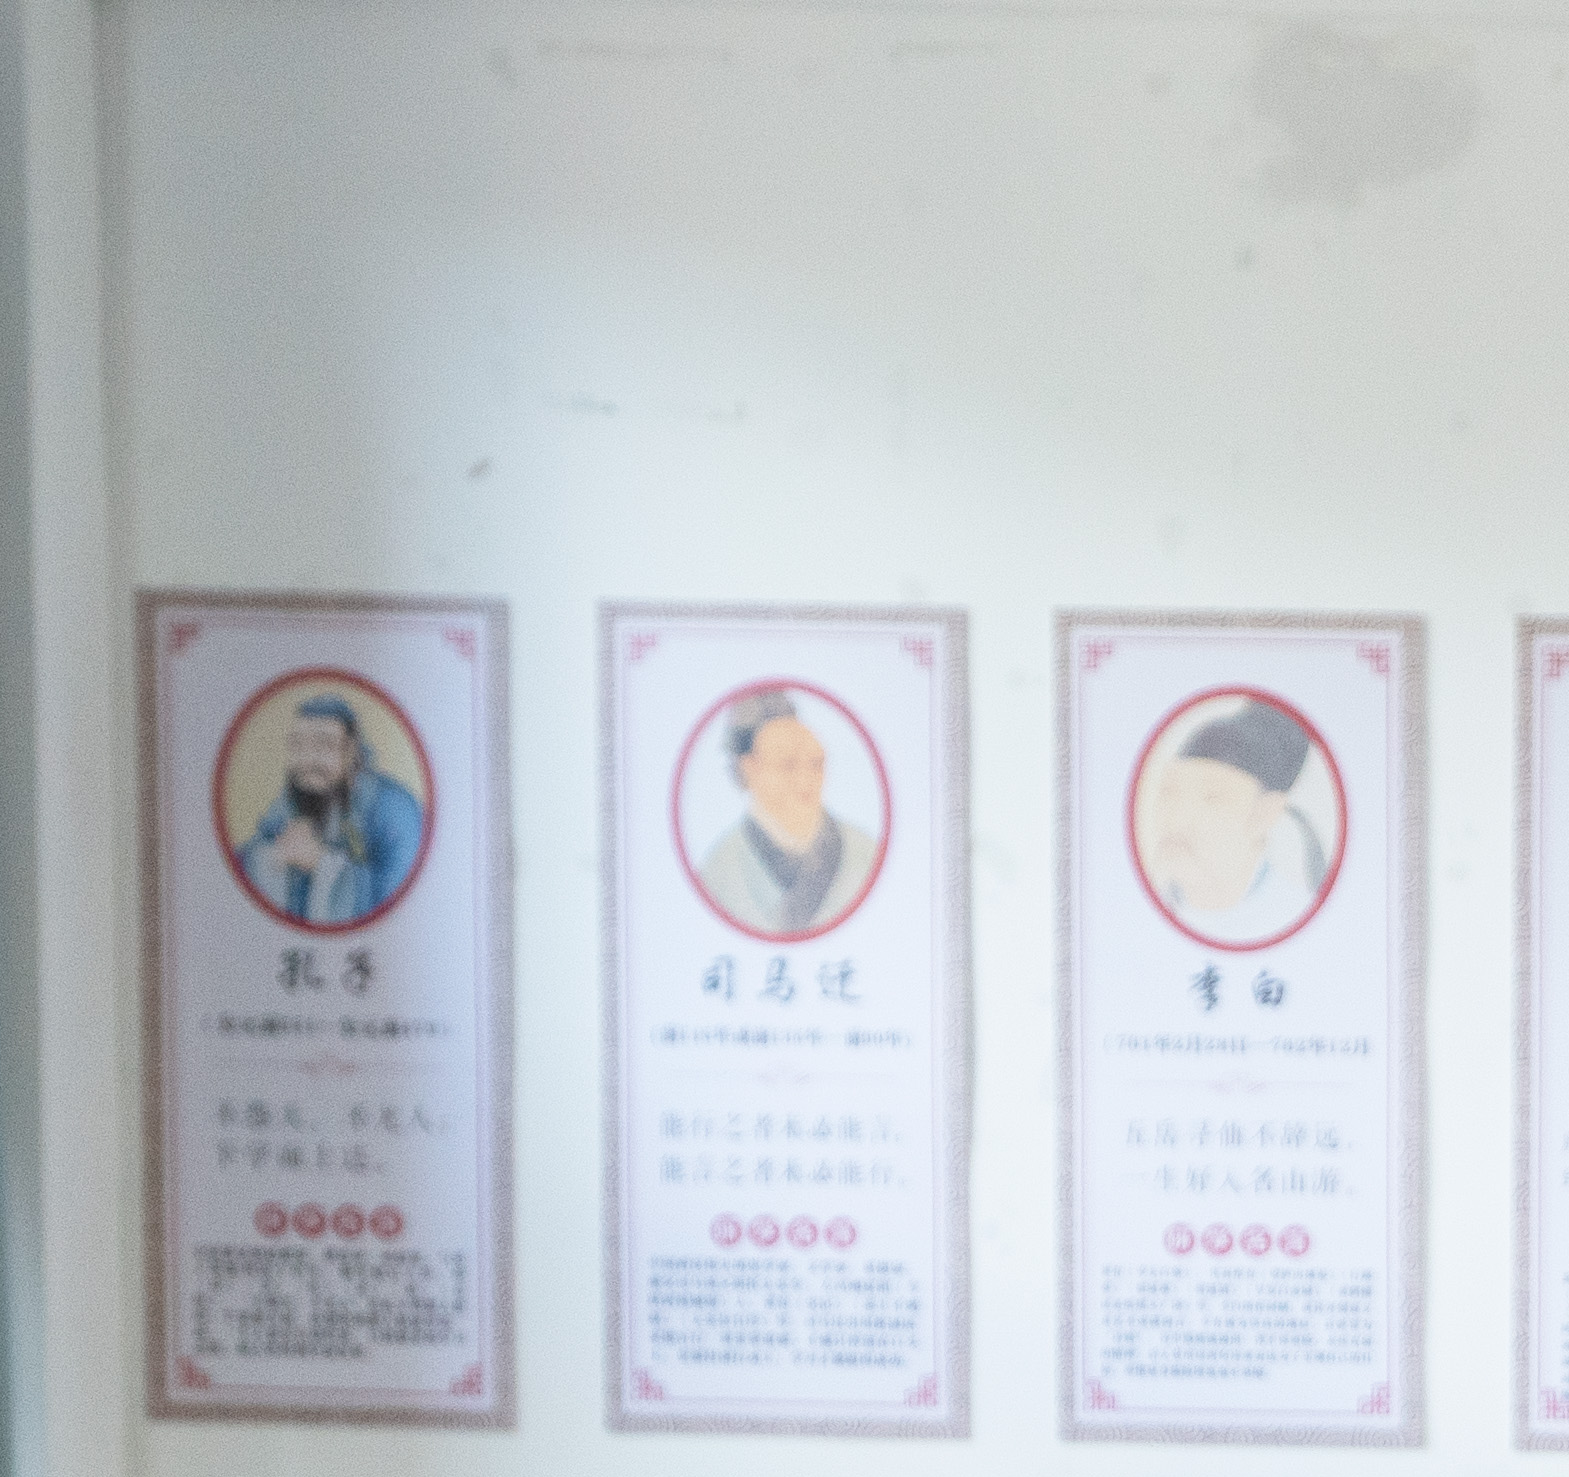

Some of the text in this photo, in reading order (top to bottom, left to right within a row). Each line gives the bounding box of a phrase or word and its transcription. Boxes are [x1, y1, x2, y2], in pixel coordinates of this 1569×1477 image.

[276, 946, 376, 996] 孔子
[699, 954, 862, 1006] 司马迁
[1189, 963, 1288, 1013] 李白
